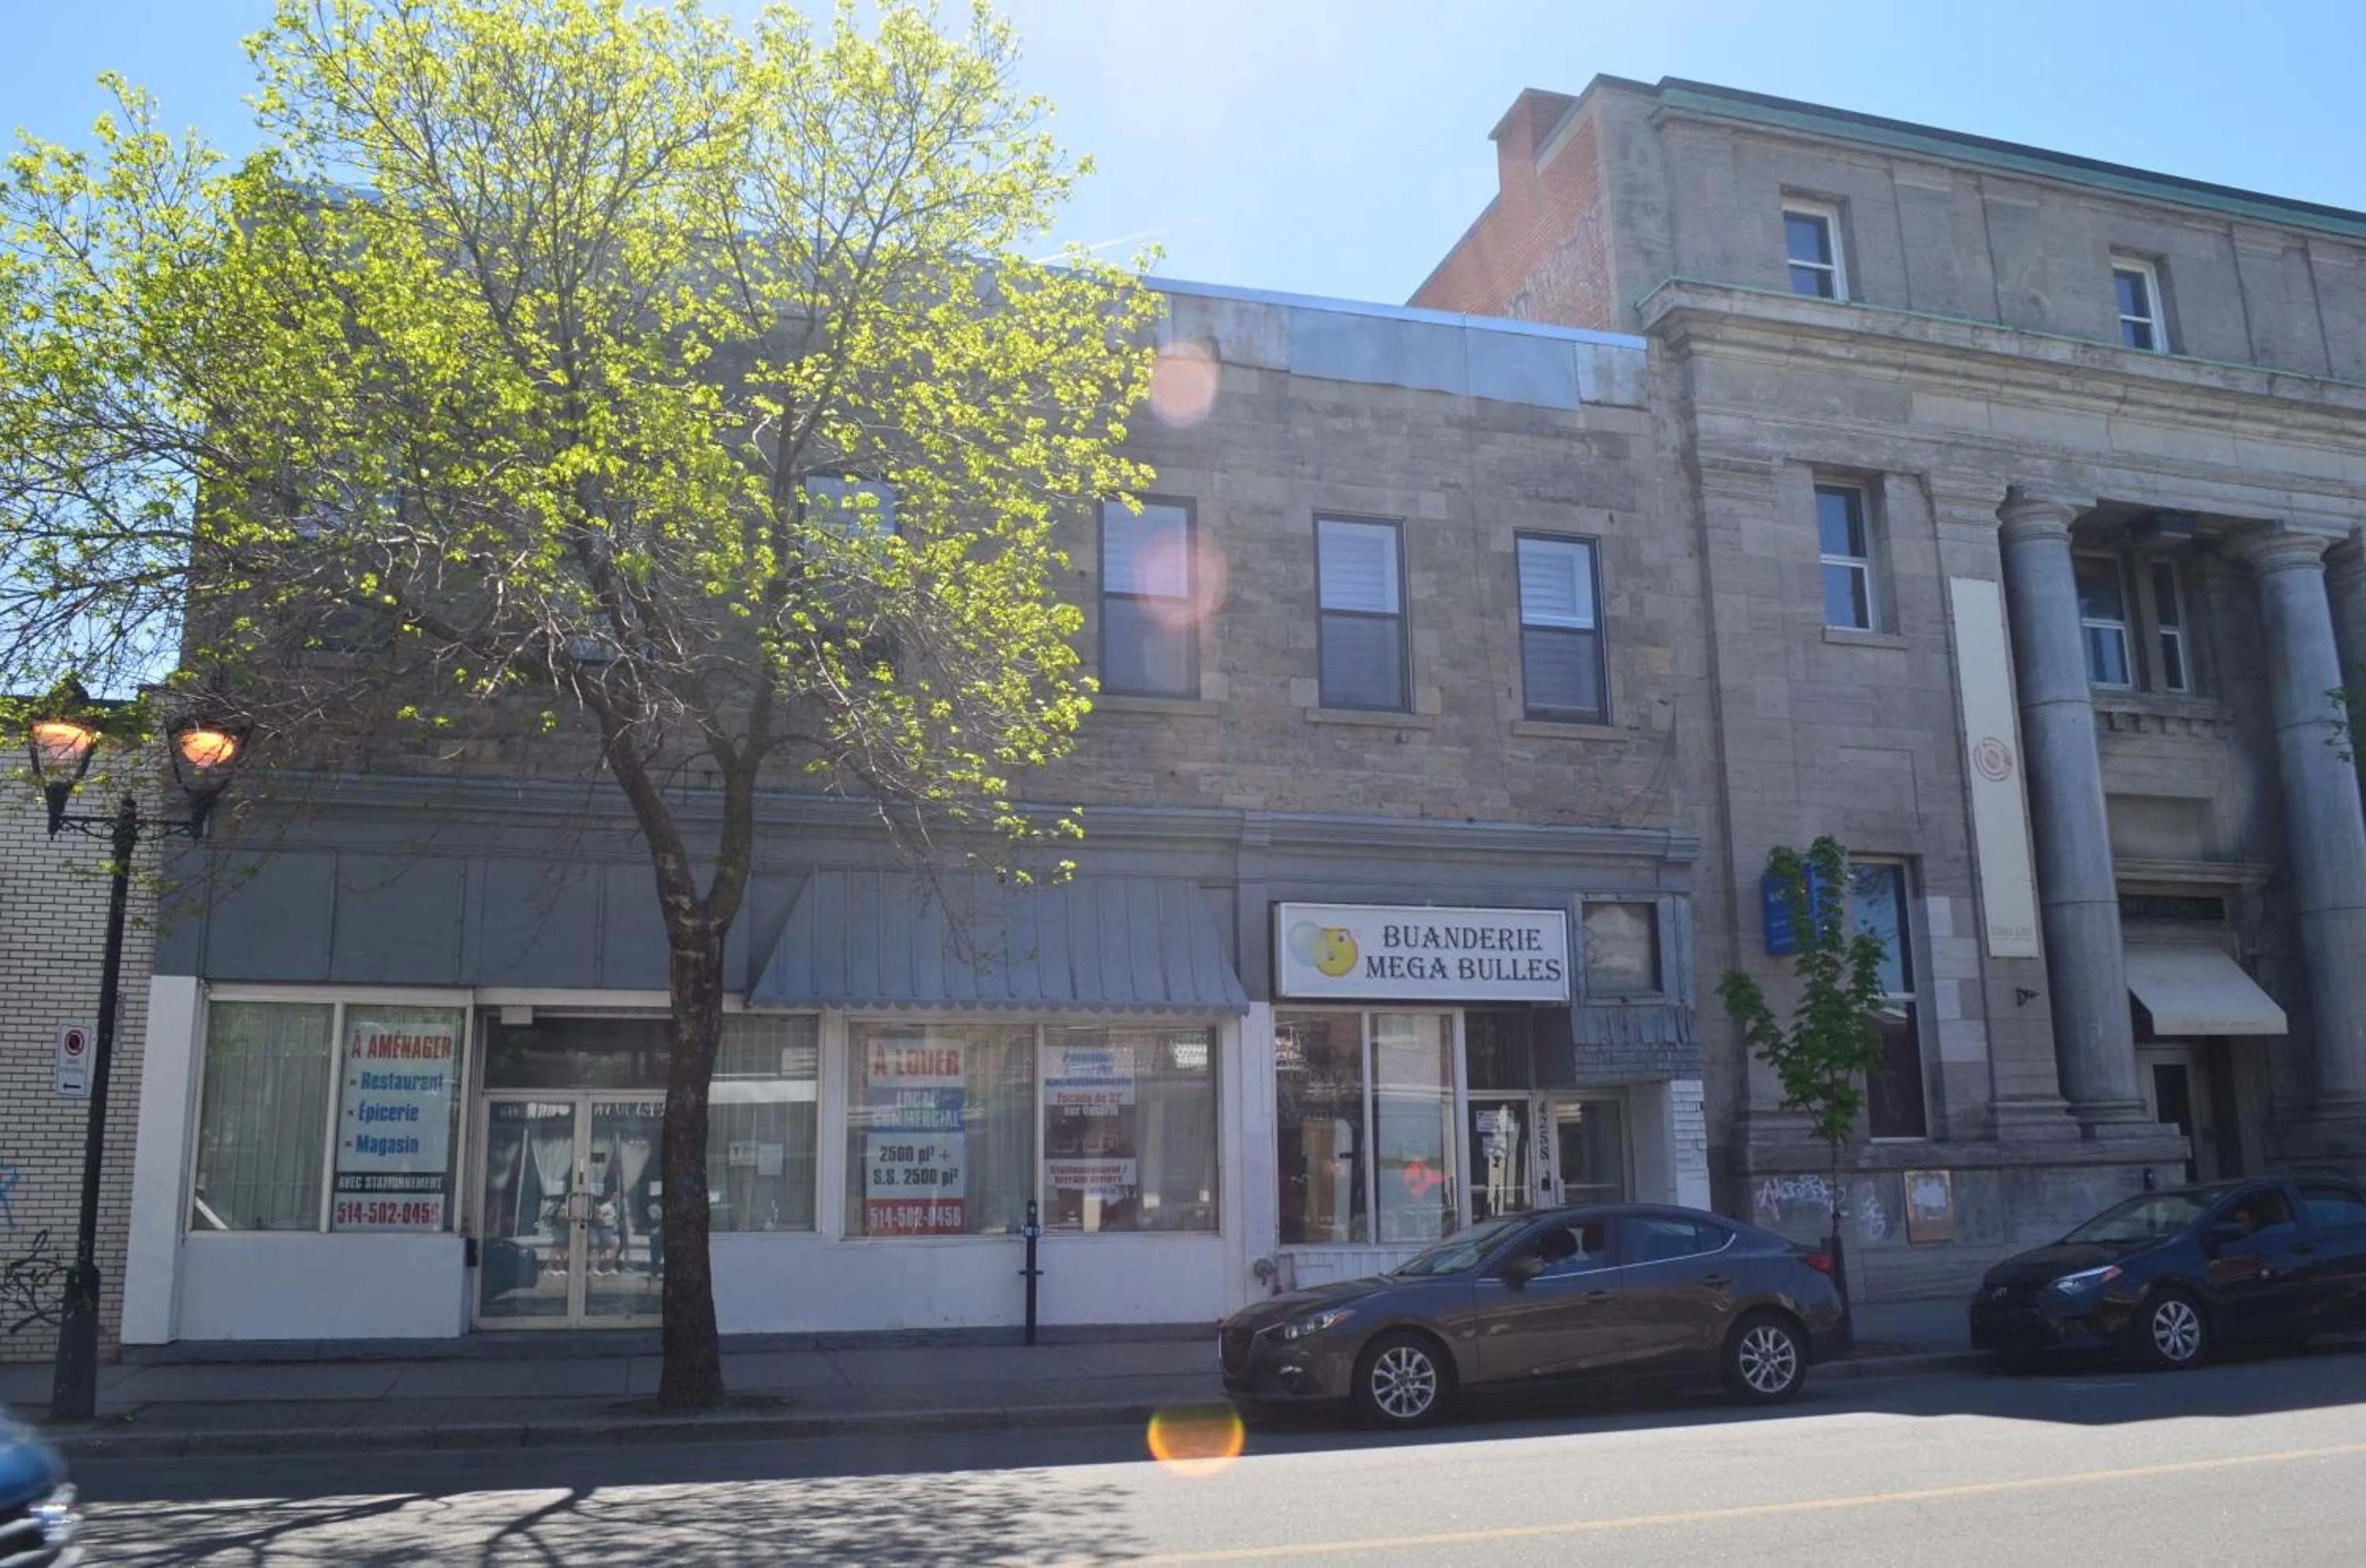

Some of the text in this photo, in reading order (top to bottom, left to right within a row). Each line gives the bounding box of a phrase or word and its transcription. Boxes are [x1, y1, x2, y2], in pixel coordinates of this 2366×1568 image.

[1383, 925, 1543, 952] BUANDERIE
[1366, 956, 1562, 982] MEGA BULLES
[368, 1030, 452, 1059] AMÉNAGER
[896, 1049, 960, 1076] LOUER
[361, 1072, 443, 1092] Restaurant
[358, 1100, 420, 1124] Épicerie
[356, 1135, 420, 1156] Magasin
[879, 1146, 913, 1163] 2500
[338, 1176, 442, 1189] AVEC STATIONNEMENT
[873, 1168, 899, 1185] S.S.
[903, 1169, 937, 1185] 2500
